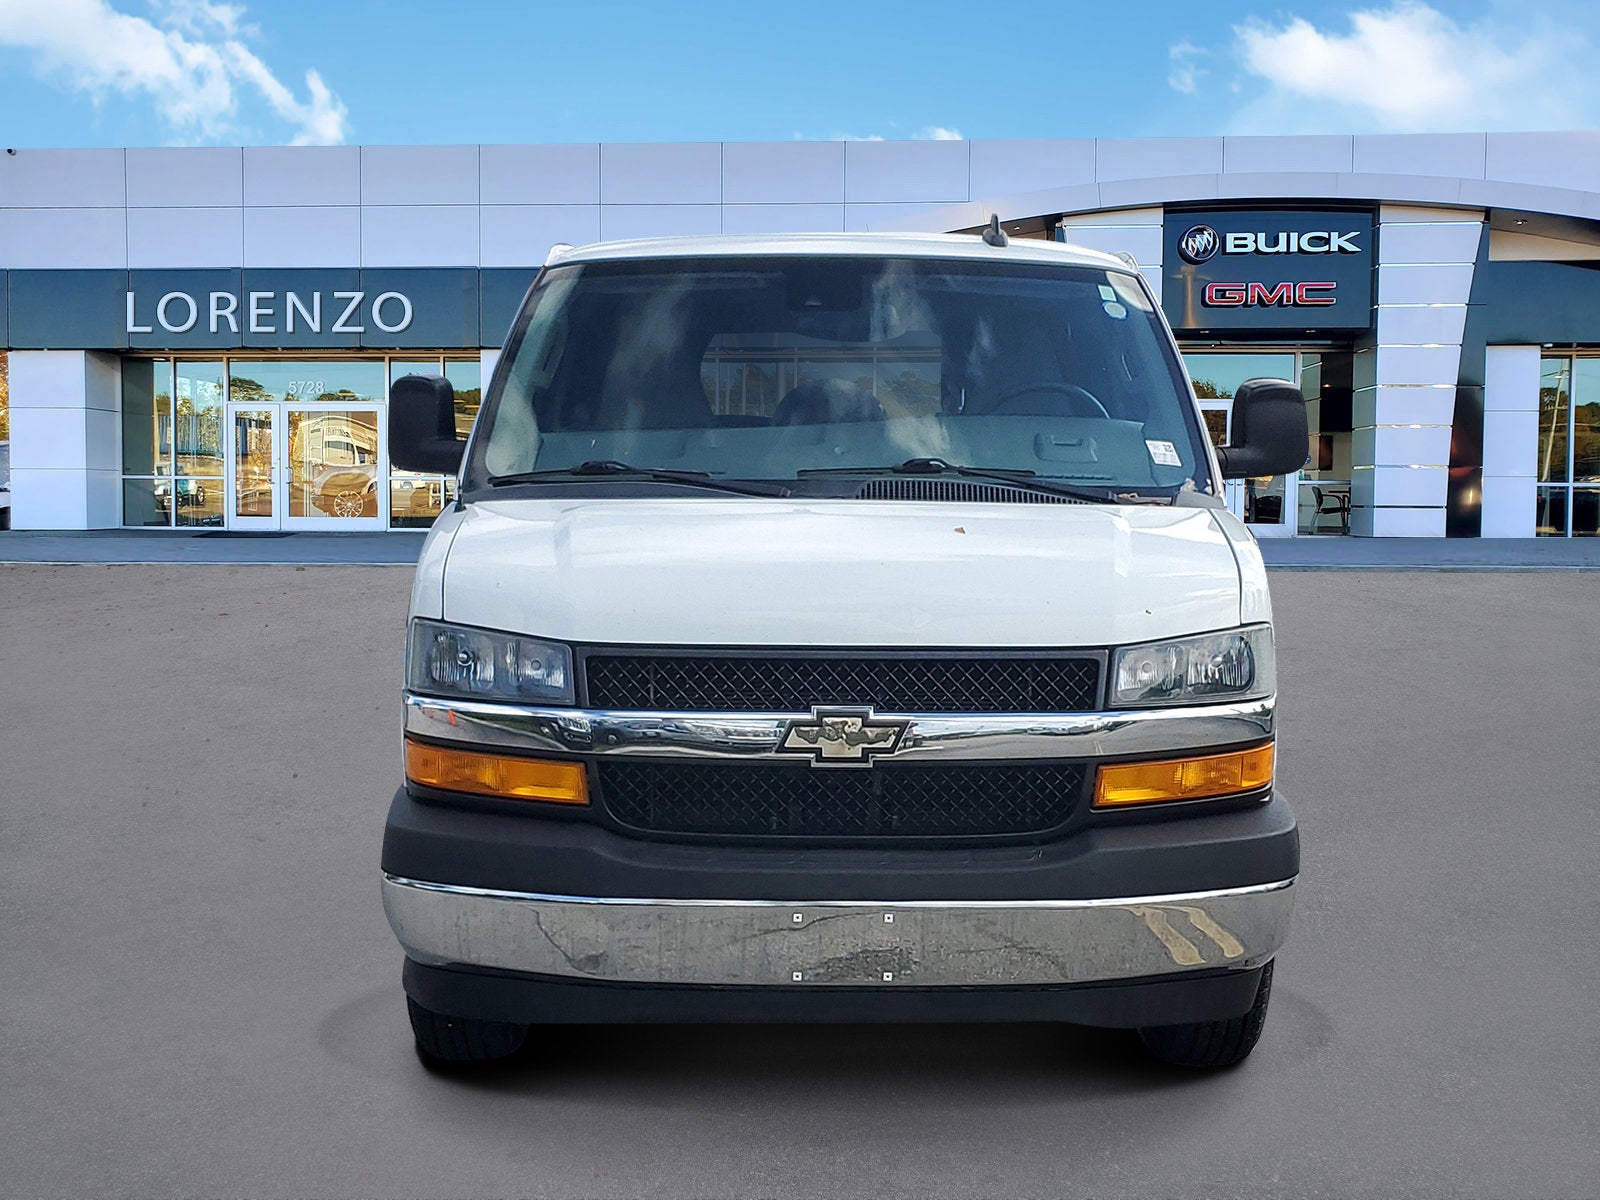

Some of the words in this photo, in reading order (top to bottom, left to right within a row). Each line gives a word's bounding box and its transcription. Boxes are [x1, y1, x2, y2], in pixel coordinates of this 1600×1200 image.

[1225, 231, 1362, 253] BUICK
[1206, 281, 1337, 305] GMC
[126, 291, 414, 334] LORENZO
[288, 380, 325, 394] 5728
